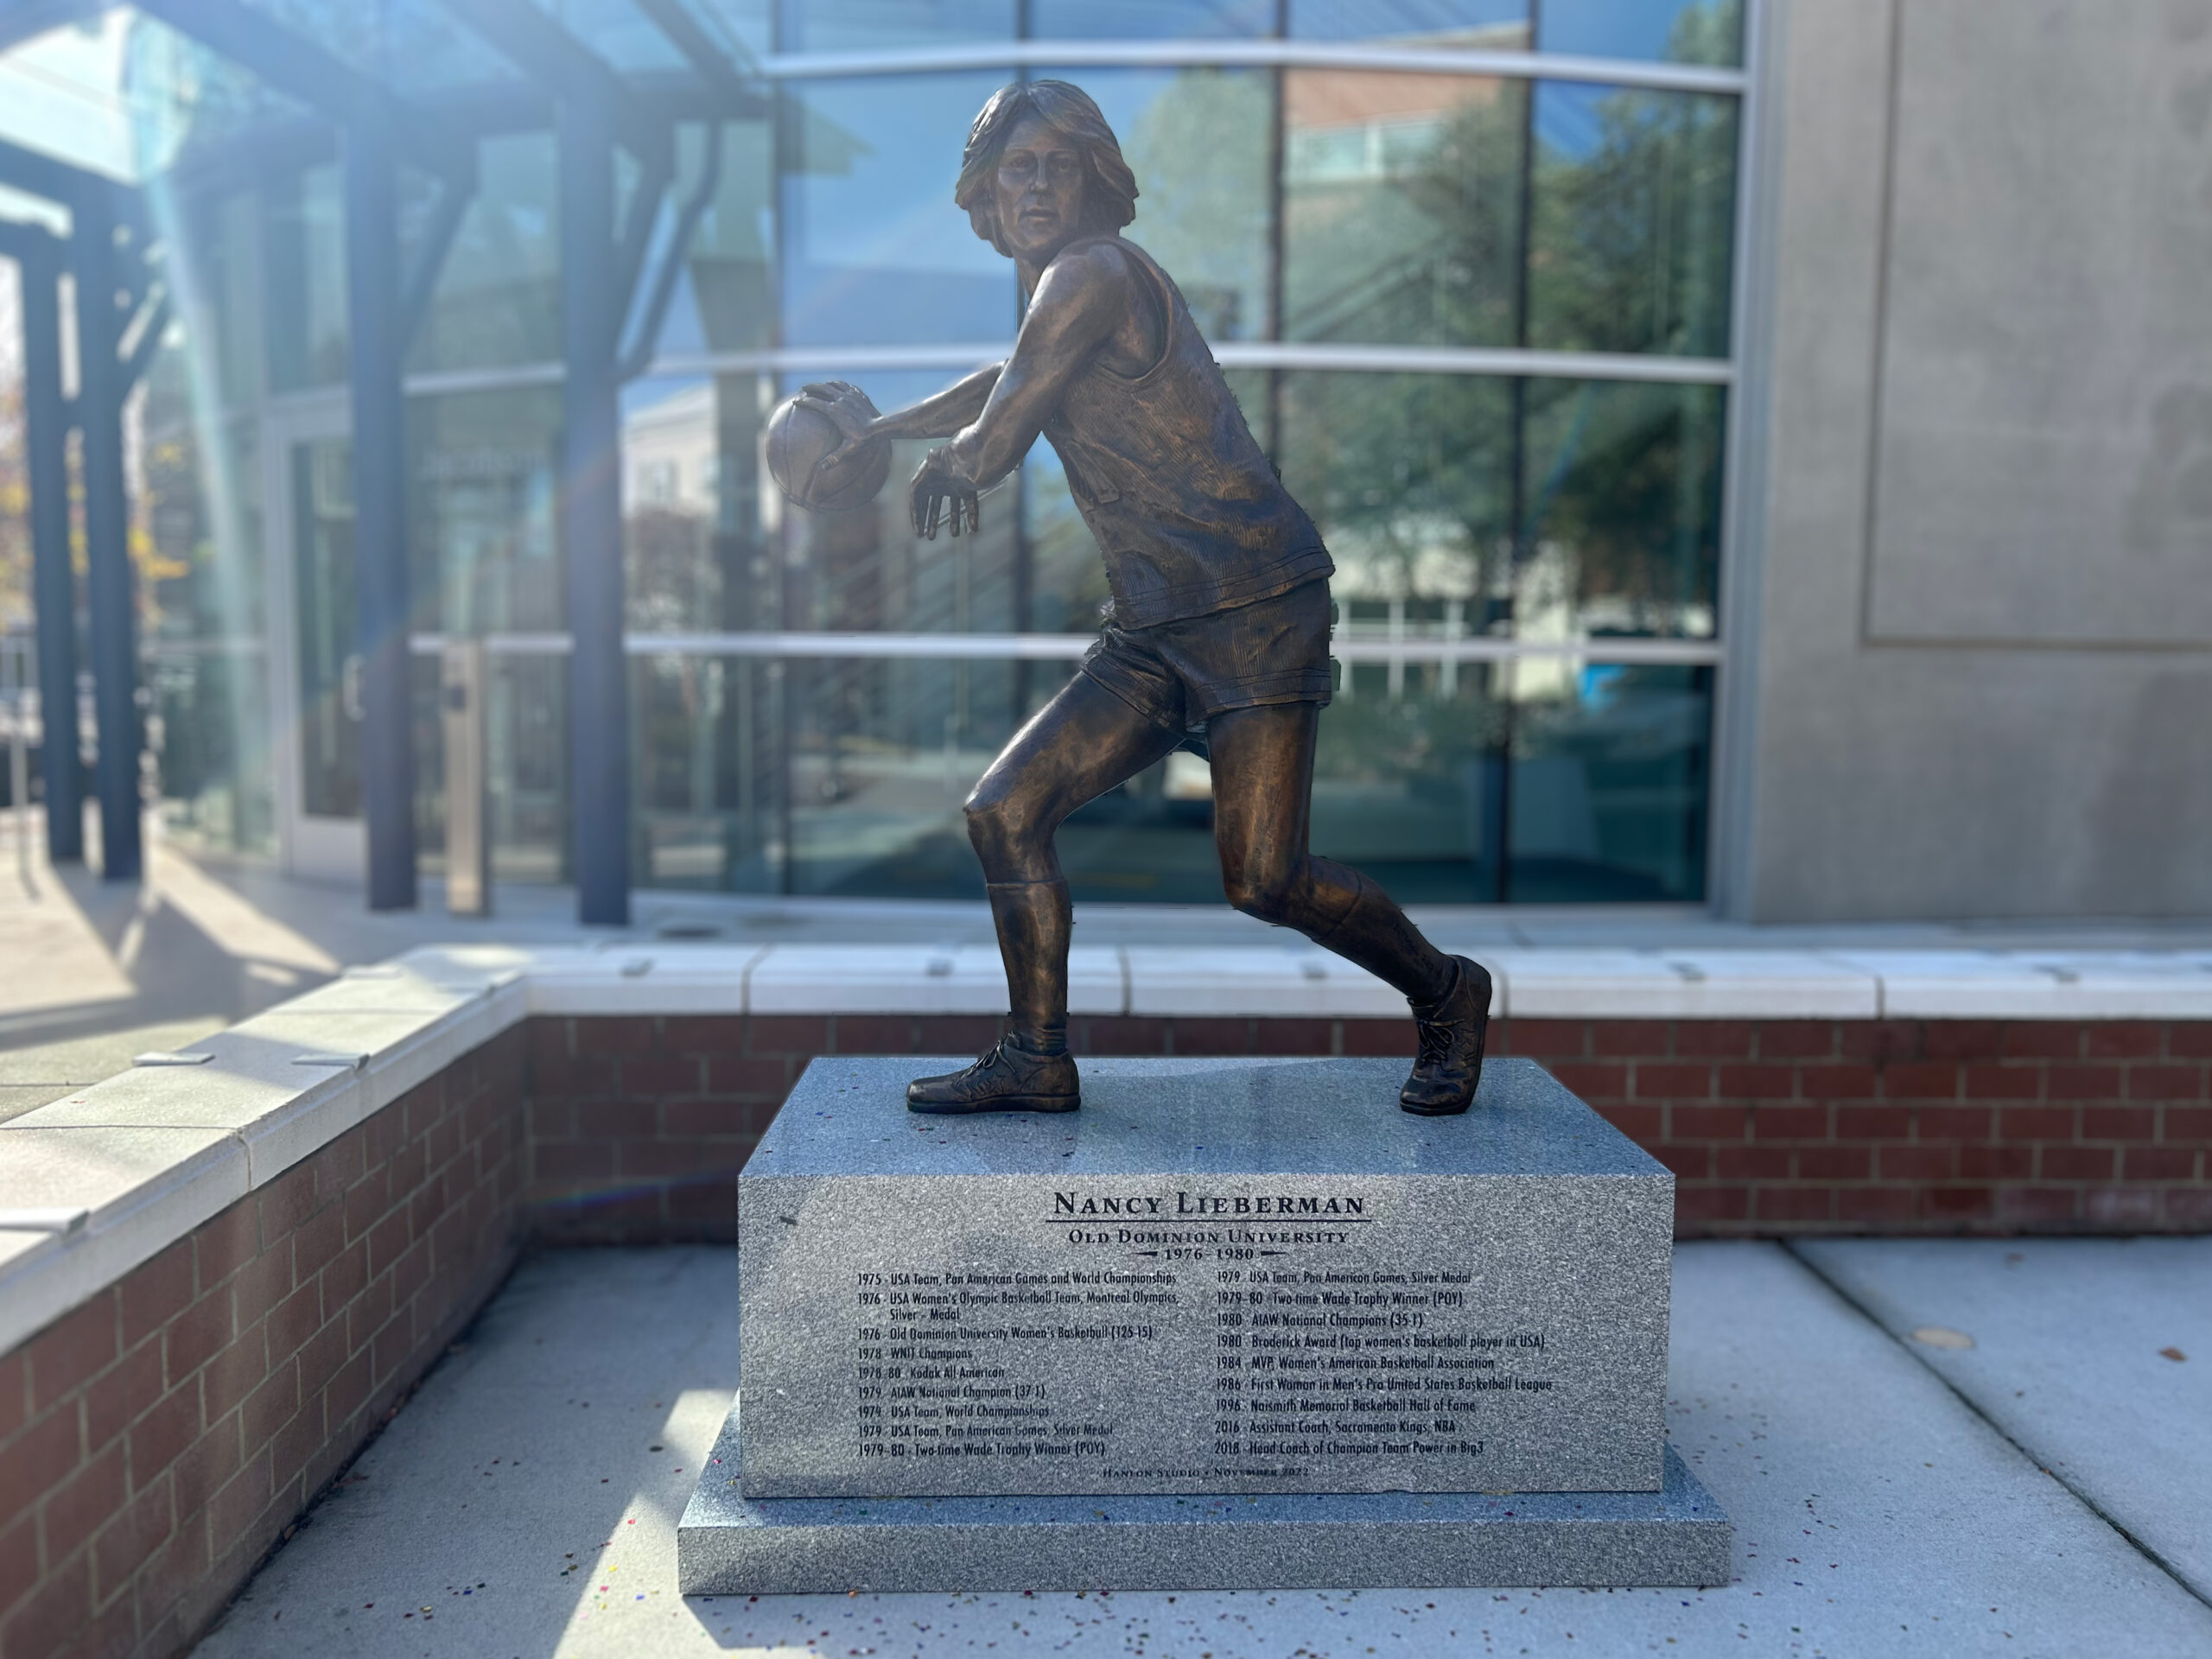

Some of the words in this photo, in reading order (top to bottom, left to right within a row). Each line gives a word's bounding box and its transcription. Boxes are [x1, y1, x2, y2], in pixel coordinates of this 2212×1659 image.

[1053, 1192, 1162, 1213] NANCY
[1177, 1192, 1364, 1213] LIEBERMAN
[1069, 1229, 1109, 1243] OLD
[1118, 1229, 1218, 1243] DOMINION
[1229, 1229, 1350, 1243] UNIVERSITY
[858, 1274, 881, 1286] 1975
[892, 1274, 910, 1285] USA
[914, 1274, 942, 1287] Team,
[946, 1274, 963, 1285] Pan
[967, 1273, 1012, 1285] American
[1015, 1273, 1047, 1284] Games
[1051, 1272, 1069, 1284] and
[1072, 1272, 1100, 1284] World
[1104, 1271, 1176, 1286] Championships
[1217, 1271, 1240, 1283] 1979
[1250, 1271, 1268, 1283] USA
[1273, 1271, 1300, 1284] Team,
[1304, 1271, 1321, 1283] Pan
[1325, 1271, 1370, 1283] American
[1373, 1271, 1408, 1284] Games,
[1412, 1272, 1439, 1282] Silver
[1442, 1271, 1471, 1282] Medal
[858, 1293, 880, 1305] 1976
[890, 1293, 909, 1305] USA
[912, 1293, 956, 1305] Women's
[960, 1292, 998, 1306] Olympic
[1001, 1292, 1051, 1303] Basketball
[1055, 1292, 1083, 1304] Team,
[1087, 1291, 1129, 1303] Montreal
[1134, 1291, 1179, 1305] Olympics,
[1322, 1292, 1350, 1305] Wade
[1354, 1291, 1389, 1306] Trophy
[1393, 1292, 1429, 1305] Winner
[1433, 1291, 1462, 1306] (POY)
[890, 1309, 918, 1320] Silver
[930, 1307, 960, 1320] Medal
[1217, 1313, 1242, 1325] 1980
[1252, 1313, 1278, 1325] AIAW
[1282, 1313, 1325, 1325] National
[1330, 1313, 1386, 1327] Champions
[858, 1328, 880, 1340] 1976
[890, 1327, 906, 1340] Old
[911, 1328, 957, 1340] Dominion
[960, 1327, 1007, 1341] University
[1012, 1327, 1054, 1338] Women's
[1058, 1325, 1107, 1338] Basketball
[1111, 1325, 1152, 1340] (125-15)
[1217, 1335, 1242, 1347] 1980
[1252, 1334, 1300, 1347] Broderick
[1305, 1335, 1336, 1347] Award
[1340, 1334, 1360, 1350] (top
[1365, 1334, 1410, 1347] women's
[1414, 1334, 1466, 1347] basketball
[1471, 1334, 1503, 1350] player
[1506, 1336, 1516, 1347] in
[1520, 1333, 1544, 1350] USA)
[859, 1348, 880, 1359] 1978
[919, 1347, 972, 1361] Champions
[1217, 1357, 1241, 1369] 1984
[1279, 1357, 1325, 1369] Women's
[1329, 1356, 1376, 1369] American
[1381, 1356, 1433, 1369] Basketball
[1438, 1357, 1494, 1368] Association
[911, 1366, 940, 1378] Kodak
[1217, 1378, 1241, 1390] 1986
[1251, 1378, 1274, 1391] First
[1277, 1378, 1315, 1390] Woman
[1319, 1379, 1328, 1390] in
[1333, 1378, 1362, 1390] Men's
[1366, 1378, 1383, 1390] Pro
[1388, 1377, 1421, 1390] United
[1425, 1377, 1455, 1389] States
[1459, 1376, 1510, 1389] Basketball
[1515, 1377, 1552, 1393] League
[859, 1387, 881, 1398] 1979
[891, 1387, 914, 1398] AIAW
[919, 1385, 960, 1398] National
[963, 1385, 1011, 1399] Champion
[859, 1406, 881, 1418] 1979
[892, 1406, 910, 1417] USA
[914, 1406, 942, 1419] Team,
[945, 1405, 973, 1417] World
[977, 1405, 1049, 1418] Championships
[1216, 1400, 1240, 1411] 1996
[1251, 1399, 1296, 1412] Naismith
[1300, 1399, 1348, 1412] Memorial
[1353, 1398, 1405, 1411] Basketball
[1410, 1398, 1430, 1411] Hall
[1433, 1398, 1443, 1411] of
[1448, 1400, 1475, 1411] Fame
[859, 1425, 881, 1437] 1979
[892, 1426, 910, 1437] USA
[914, 1426, 942, 1439] Team,
[946, 1425, 963, 1436] Pan
[967, 1425, 1011, 1436] American
[1054, 1424, 1080, 1435] Silver
[1084, 1424, 1113, 1434] Medal
[1215, 1421, 1239, 1433] 2016
[1250, 1421, 1294, 1433] Assistant
[1299, 1421, 1332, 1434] Coach,
[1336, 1421, 1395, 1432] Sacramento
[1434, 1421, 1455, 1432] NBA
[916, 1443, 960, 1456] Two-time
[964, 1443, 992, 1455] Wade
[996, 1442, 1030, 1456] Trophy
[1035, 1443, 1071, 1454] Winner
[1076, 1441, 1105, 1456] (POY)
[1215, 1441, 1239, 1454] 2018
[1250, 1442, 1275, 1454] Head
[1280, 1441, 1308, 1454] Coach
[1313, 1441, 1324, 1454] of
[1327, 1441, 1378, 1456] Champion
[1382, 1442, 1409, 1453] Team
[1413, 1441, 1443, 1454] Power
[1447, 1442, 1456, 1452] in
[1461, 1441, 1484, 1456] Big3
